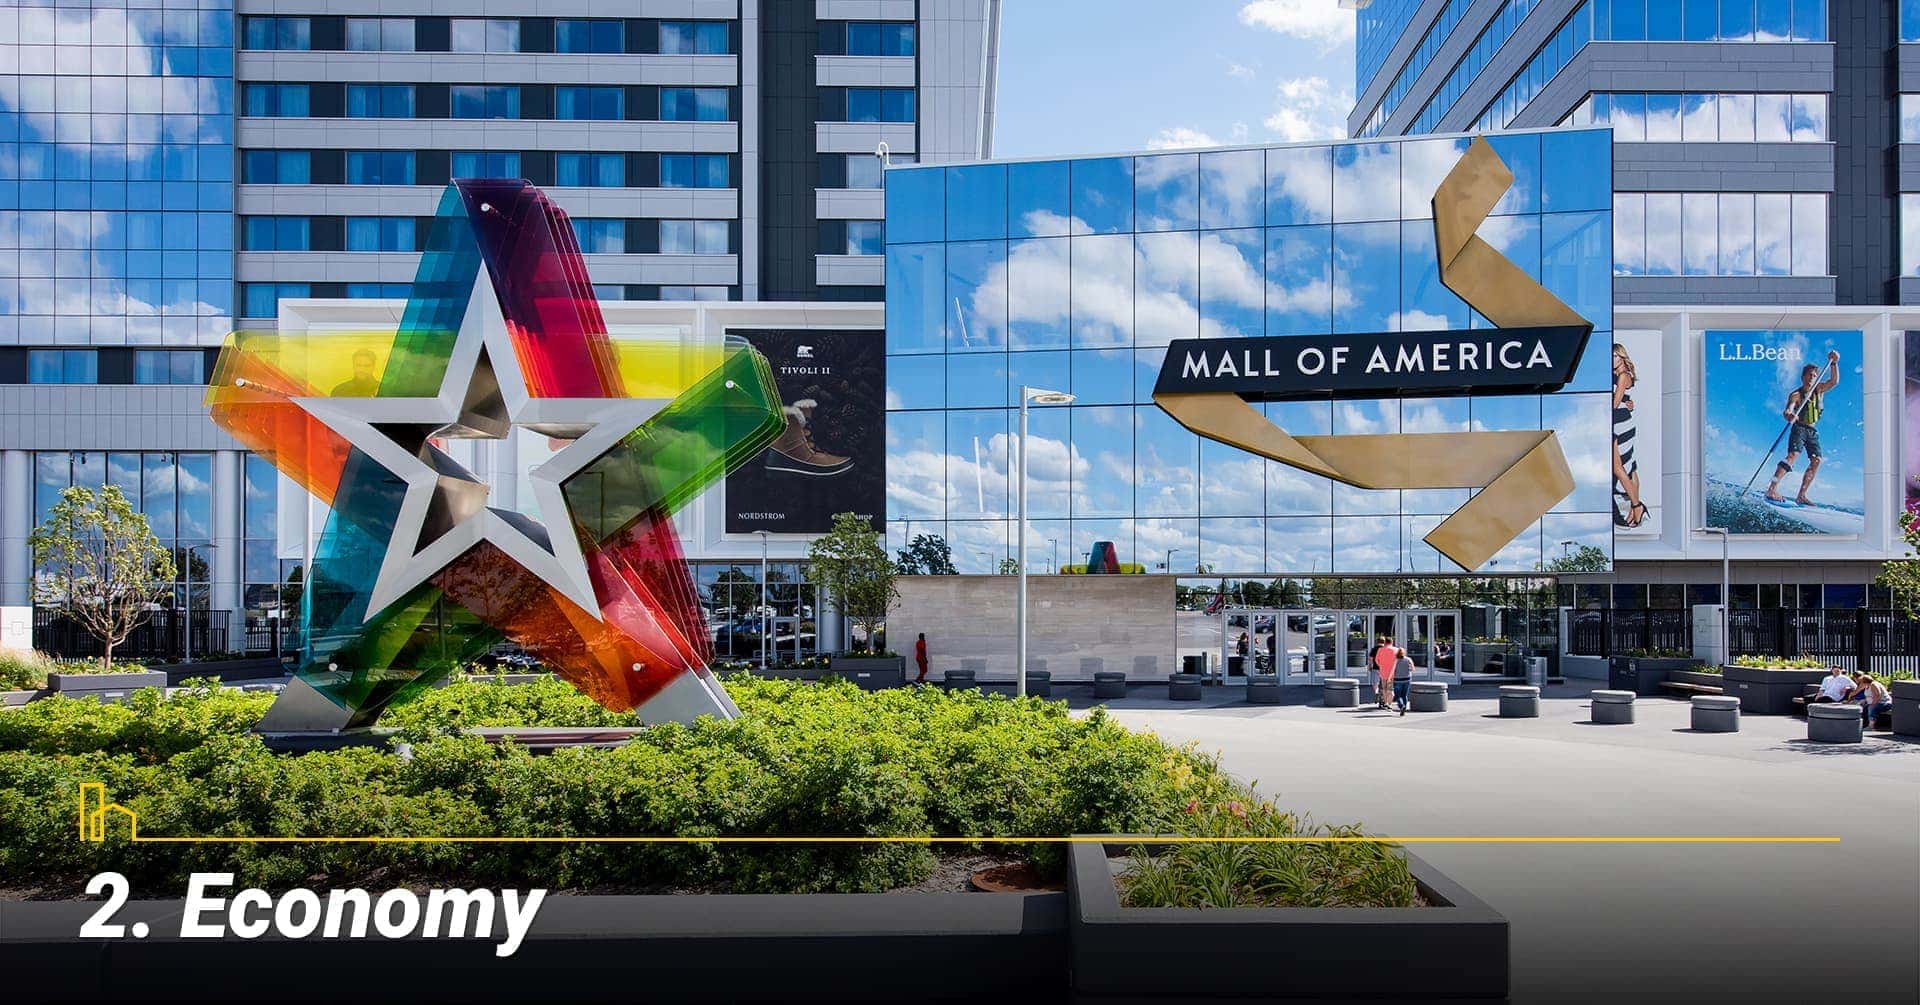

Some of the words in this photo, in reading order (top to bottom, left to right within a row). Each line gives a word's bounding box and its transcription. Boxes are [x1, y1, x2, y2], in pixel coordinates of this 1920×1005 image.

[1719, 343, 1802, 361] L.L.Bean
[1182, 349, 1280, 379] MALL
[1297, 346, 1350, 375] OF
[1364, 339, 1553, 373] AMERICA
[780, 366, 818, 375] TIVOLI
[822, 367, 830, 375] II
[738, 512, 785, 520] NORDSTROM
